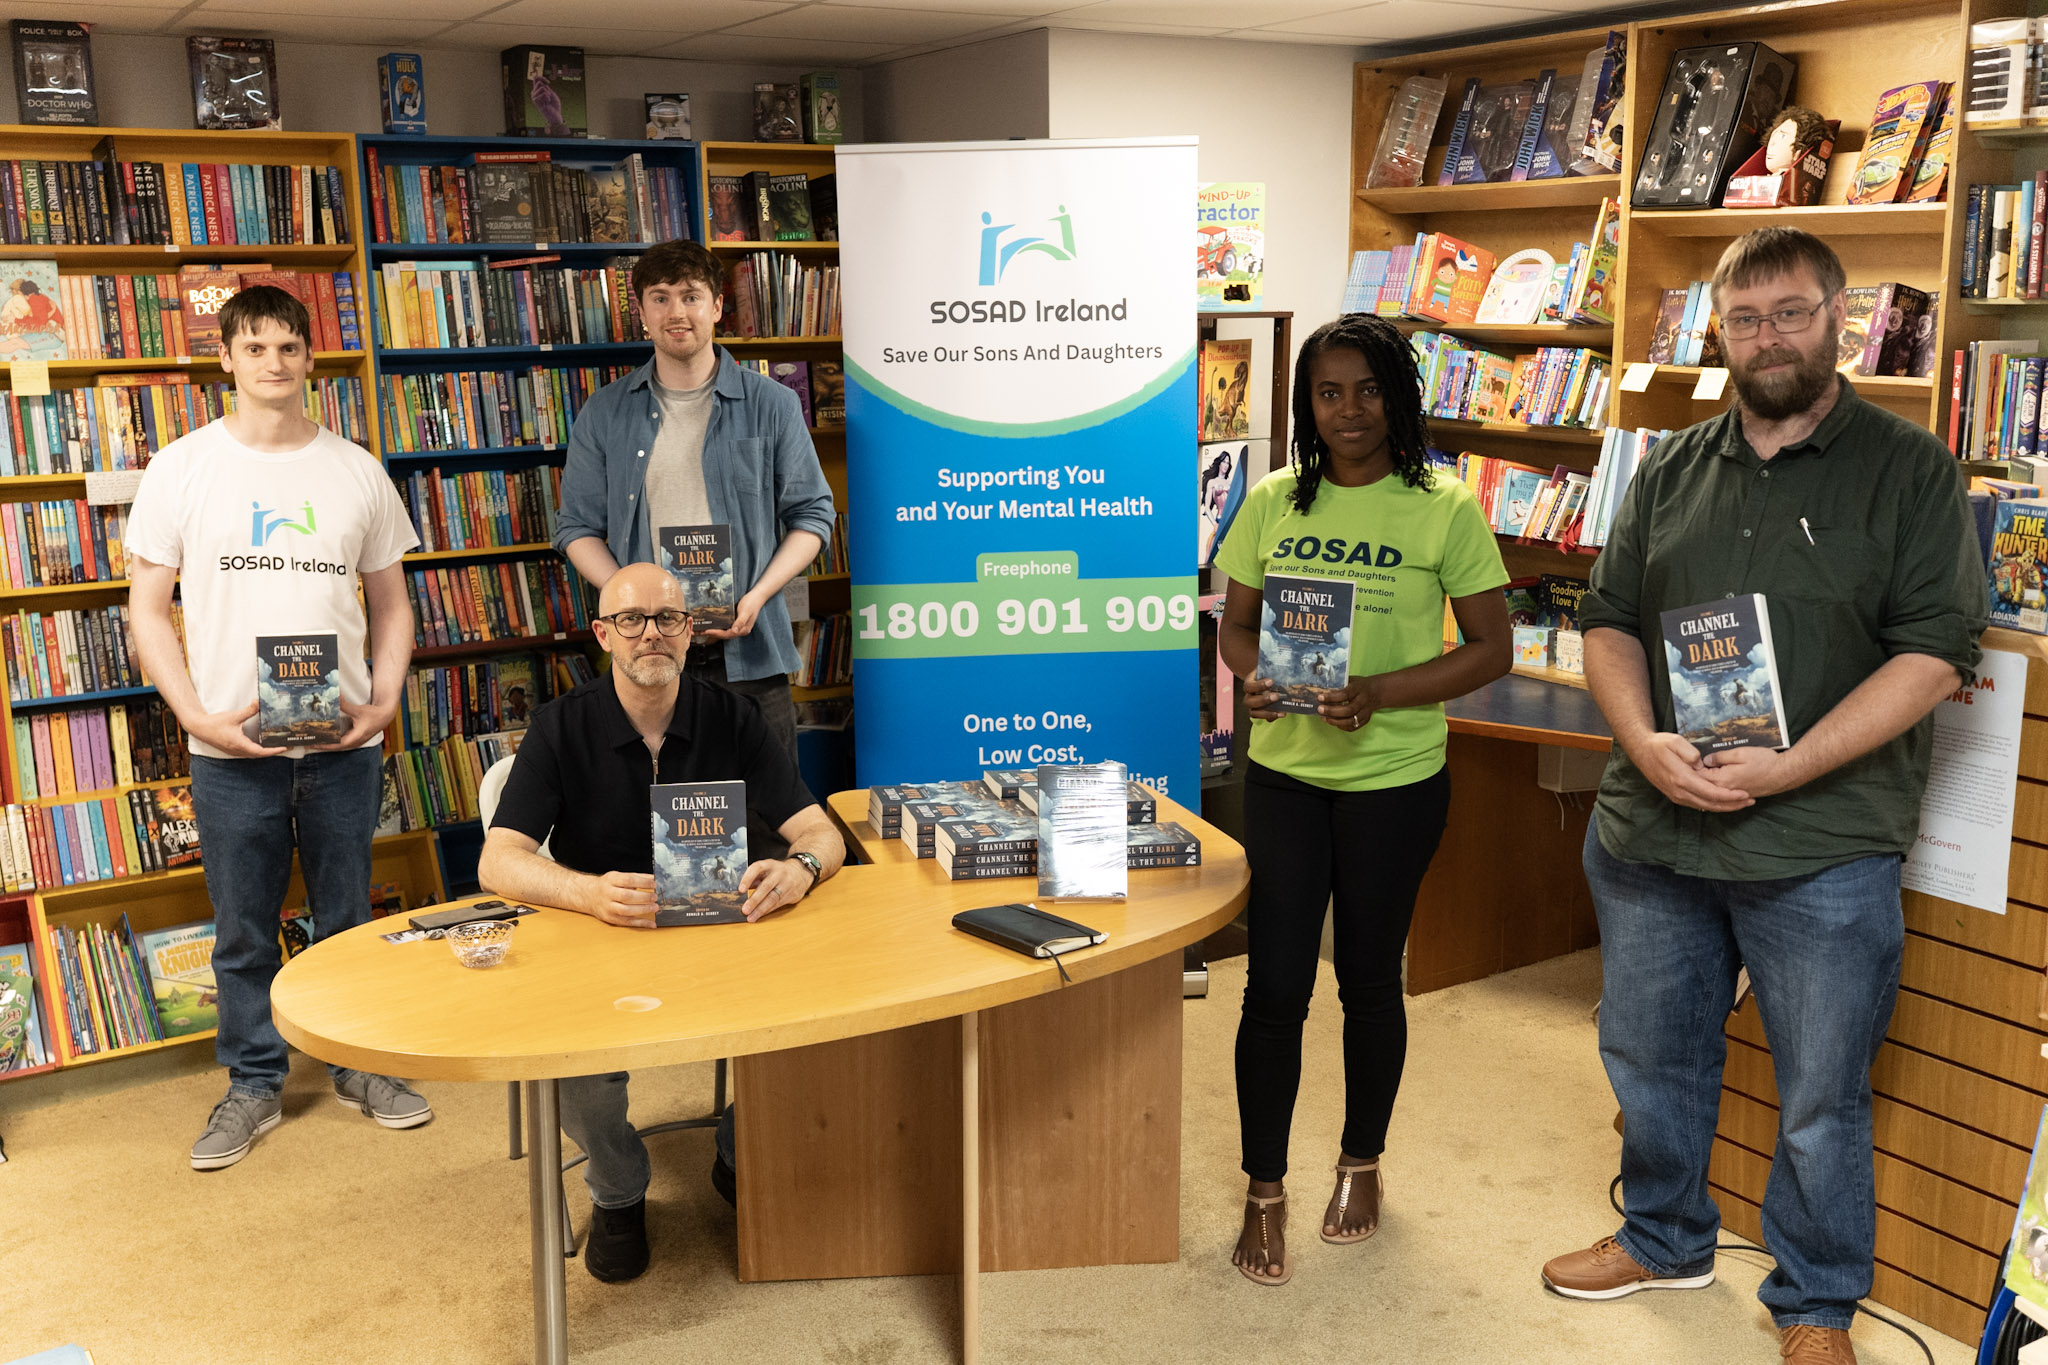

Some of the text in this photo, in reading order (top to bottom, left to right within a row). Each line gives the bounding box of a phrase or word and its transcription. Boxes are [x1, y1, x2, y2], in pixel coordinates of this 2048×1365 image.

[67, 29, 82, 37] BOX
[396, 61, 416, 73] HULK
[28, 99, 91, 109] DOCTOR WHO
[1444, 112, 1469, 175] JOHN WICK
[1517, 105, 1544, 169] JOHN WICK
[634, 158, 643, 176] POSTER
[1802, 163, 1827, 181] WARS
[1804, 154, 1827, 170] STAR
[26, 168, 41, 209] FURYSONG
[45, 169, 59, 210] FIREBORNE
[134, 167, 145, 197] NESS
[144, 166, 155, 196] NESS
[711, 184, 743, 193] AOLINI
[770, 181, 807, 192] AOLINI
[85, 171, 98, 213] ECHO NORTH
[1199, 189, 1251, 202] WIND-UP
[168, 174, 186, 243] PATRICK NESS
[186, 174, 202, 242] PATRICK NESS
[203, 174, 219, 242] PATRICK NESS
[459, 178, 471, 240] DARKLY
[2030, 250, 2039, 283] STEADMAN
[616, 271, 628, 313] EXTRAS
[1458, 276, 1484, 293] POTTY
[189, 287, 235, 303] BOOK
[930, 298, 1128, 324] SOSAD Ireland
[883, 342, 1163, 365] Save Our Sons And Daughters
[1528, 370, 1537, 391] CAPTAIN
[459, 420, 467, 442] SACHAR
[937, 466, 1105, 492] Supporting You
[896, 496, 1153, 522] and Your Mental Health
[2014, 508, 2030, 516] CHRIS
[2012, 516, 2046, 536] TIME
[674, 534, 717, 546] CHANNEL
[1992, 532, 2048, 561] HUNTER
[679, 551, 715, 566] DARK
[1272, 536, 1403, 568] SOSAD
[220, 556, 347, 576] SOSAD Ireland
[983, 560, 1072, 579] Freephone
[1302, 564, 1325, 576] Sons
[1328, 568, 1345, 577] and
[1348, 570, 1396, 583] Daughters
[1280, 589, 1334, 608] CHANNEL
[1356, 585, 1394, 598] revention
[1556, 595, 1571, 607] love
[858, 594, 1195, 641] 1800 901 909
[1363, 604, 1393, 616] alone!
[1990, 610, 2019, 624] LADIATO
[1282, 610, 1329, 633] DARK
[1680, 613, 1739, 637] CHANNEL
[273, 645, 323, 657] CHANNEL
[1688, 636, 1740, 663] DARK
[278, 662, 320, 678] DARK
[963, 711, 1093, 733] One to One,
[978, 744, 1085, 766] Low Cost,
[672, 796, 728, 810] CHANNEL
[161, 820, 193, 840] ALEX
[677, 817, 725, 837] DARK
[979, 841, 1031, 852] CHANNEL THE
[1139, 846, 1153, 854] THE
[1156, 845, 1176, 853] DARK
[976, 853, 1029, 864] CHANNEL THE
[1140, 857, 1176, 866] THE DARK
[976, 865, 1028, 876] CHANNEL THE
[153, 940, 171, 949] HOW
[159, 955, 213, 976] KNIGH
